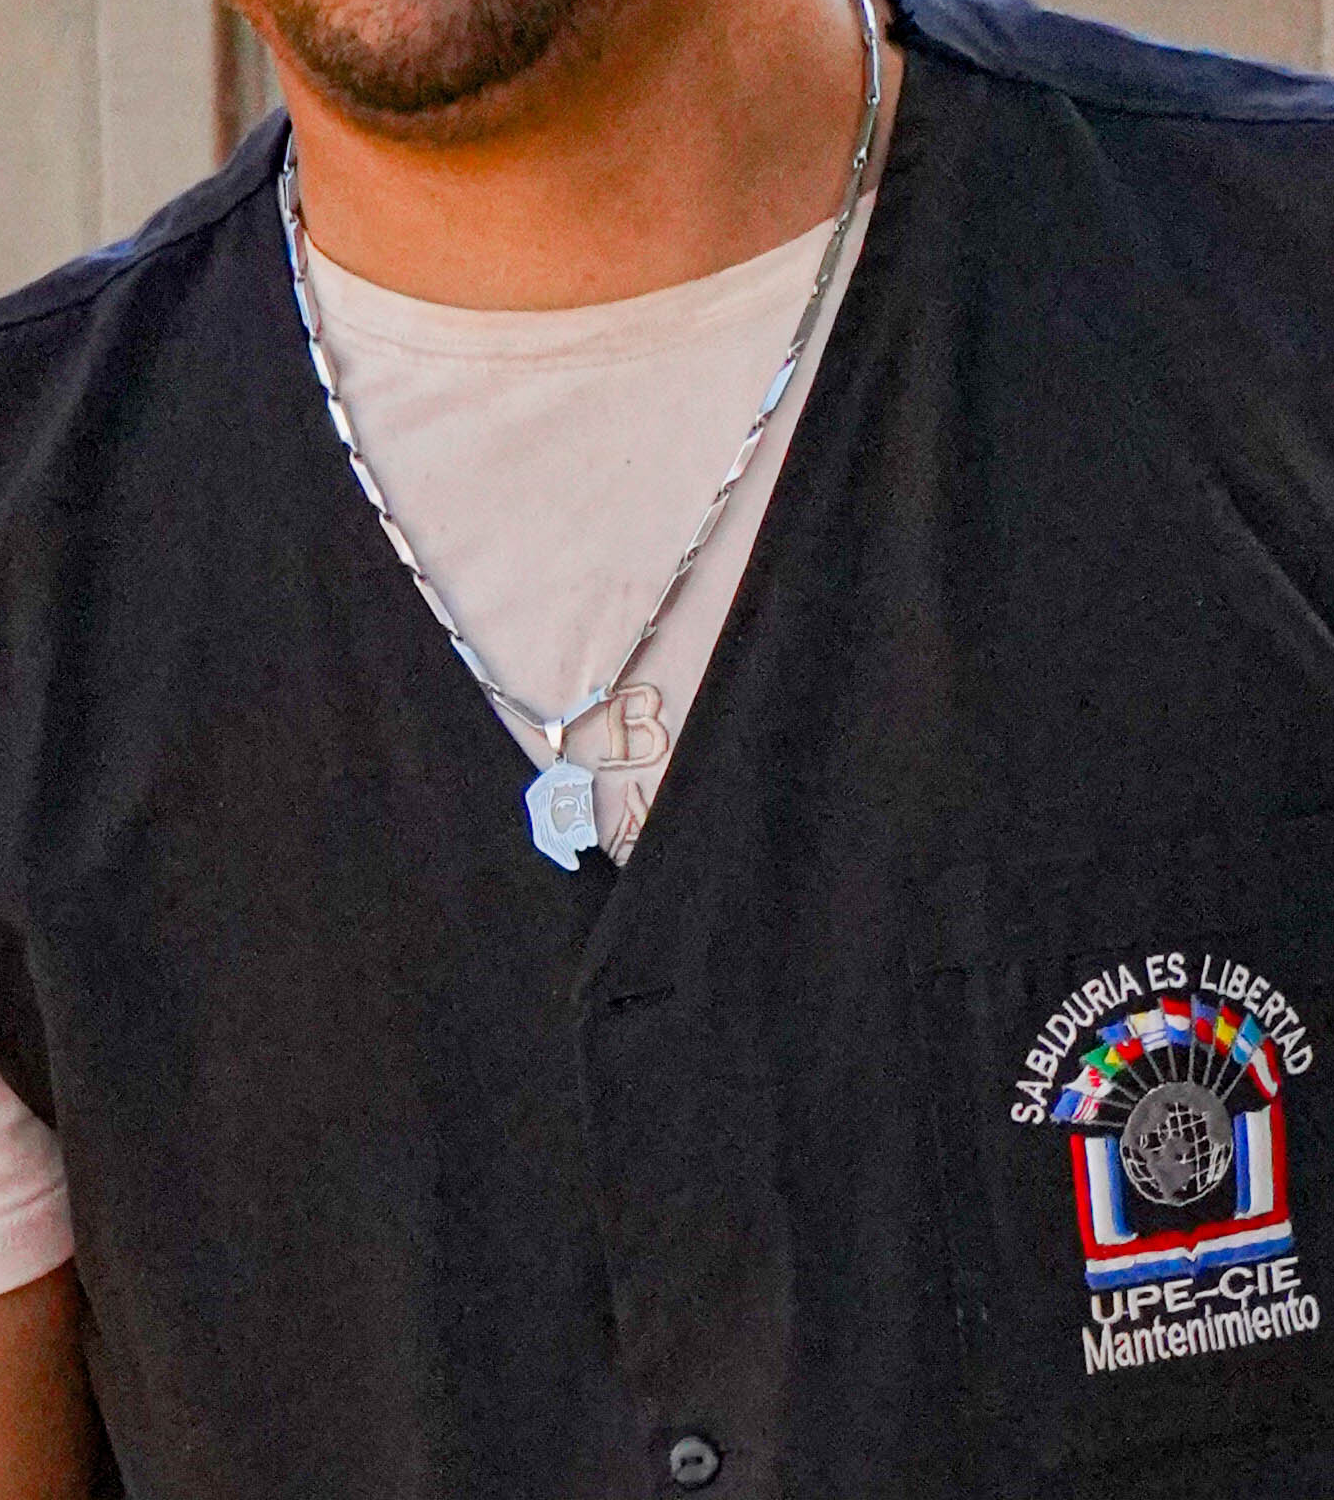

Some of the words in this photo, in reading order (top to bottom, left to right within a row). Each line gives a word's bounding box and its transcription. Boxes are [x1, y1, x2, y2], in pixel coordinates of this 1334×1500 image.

[1011, 964, 1143, 1126] SABIDURIA
[1146, 951, 1186, 990] ES
[1200, 954, 1314, 1076] LIBERTAD
[1090, 1256, 1302, 1326] UPE-CIE
[1081, 1292, 1320, 1375] Mantenimiento
